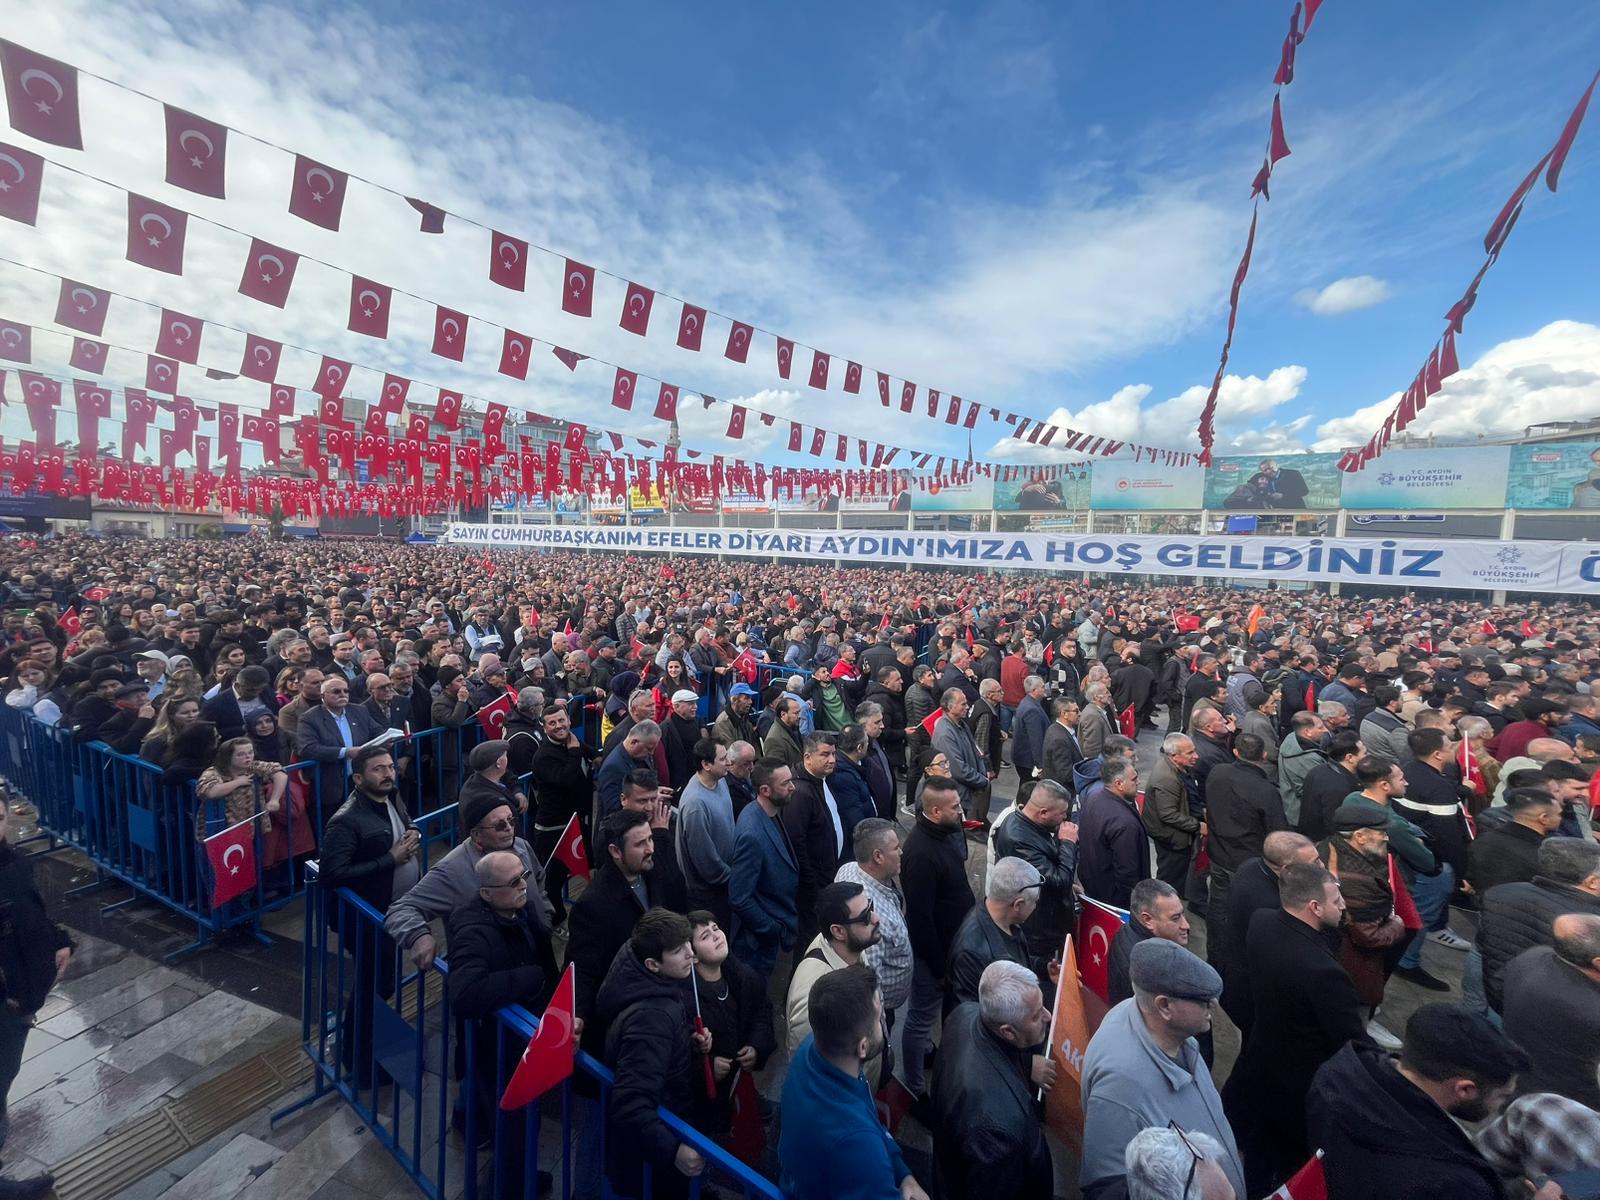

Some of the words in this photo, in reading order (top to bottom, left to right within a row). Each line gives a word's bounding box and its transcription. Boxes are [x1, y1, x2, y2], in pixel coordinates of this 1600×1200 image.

[1399, 474, 1462, 482] BÜYÜKŞEHİR
[453, 527, 489, 540] SAYIN
[491, 528, 642, 546] CUMHURBAŞKANIM
[647, 531, 722, 549] EFELER
[728, 530, 811, 553] DİYARI
[1046, 541, 1143, 571] HOŞ
[1157, 539, 1444, 577] GELDİNİZ
[1472, 570, 1541, 579] BÜYÜKŞEHİR
